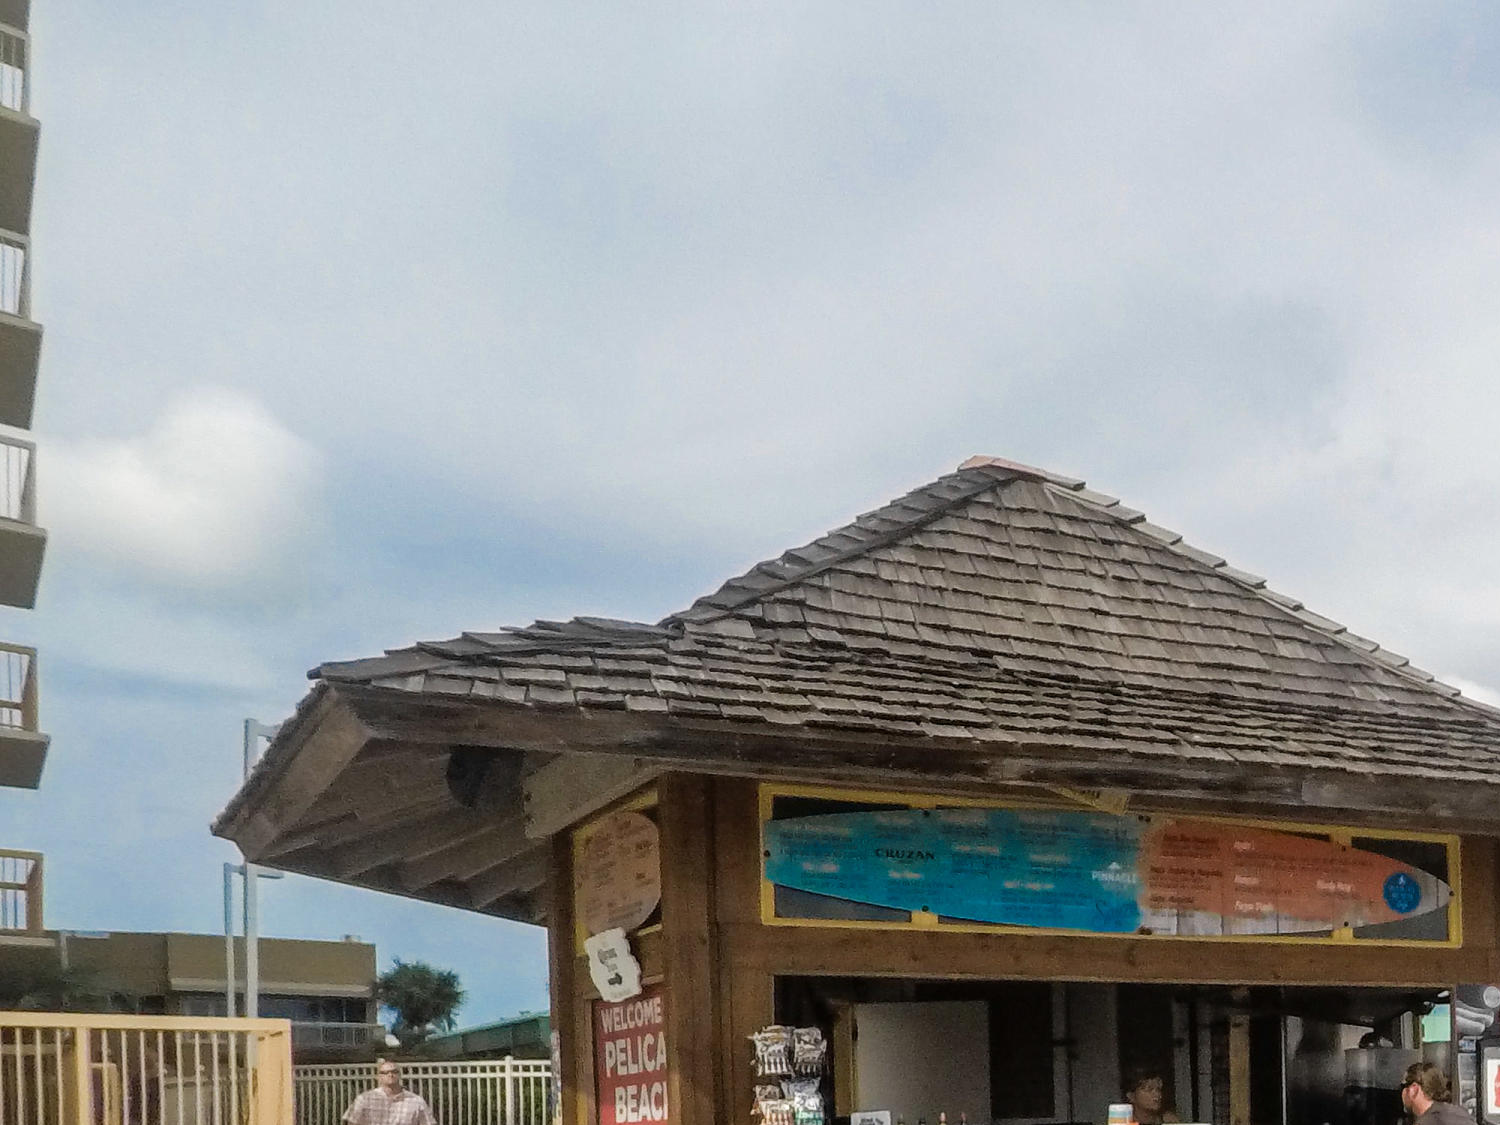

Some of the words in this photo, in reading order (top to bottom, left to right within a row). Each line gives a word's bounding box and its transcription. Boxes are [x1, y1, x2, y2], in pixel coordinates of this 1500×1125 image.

[874, 848, 935, 861] CRUZAN
[600, 997, 663, 1033] WELCOME
[605, 1031, 668, 1078] PELICA
